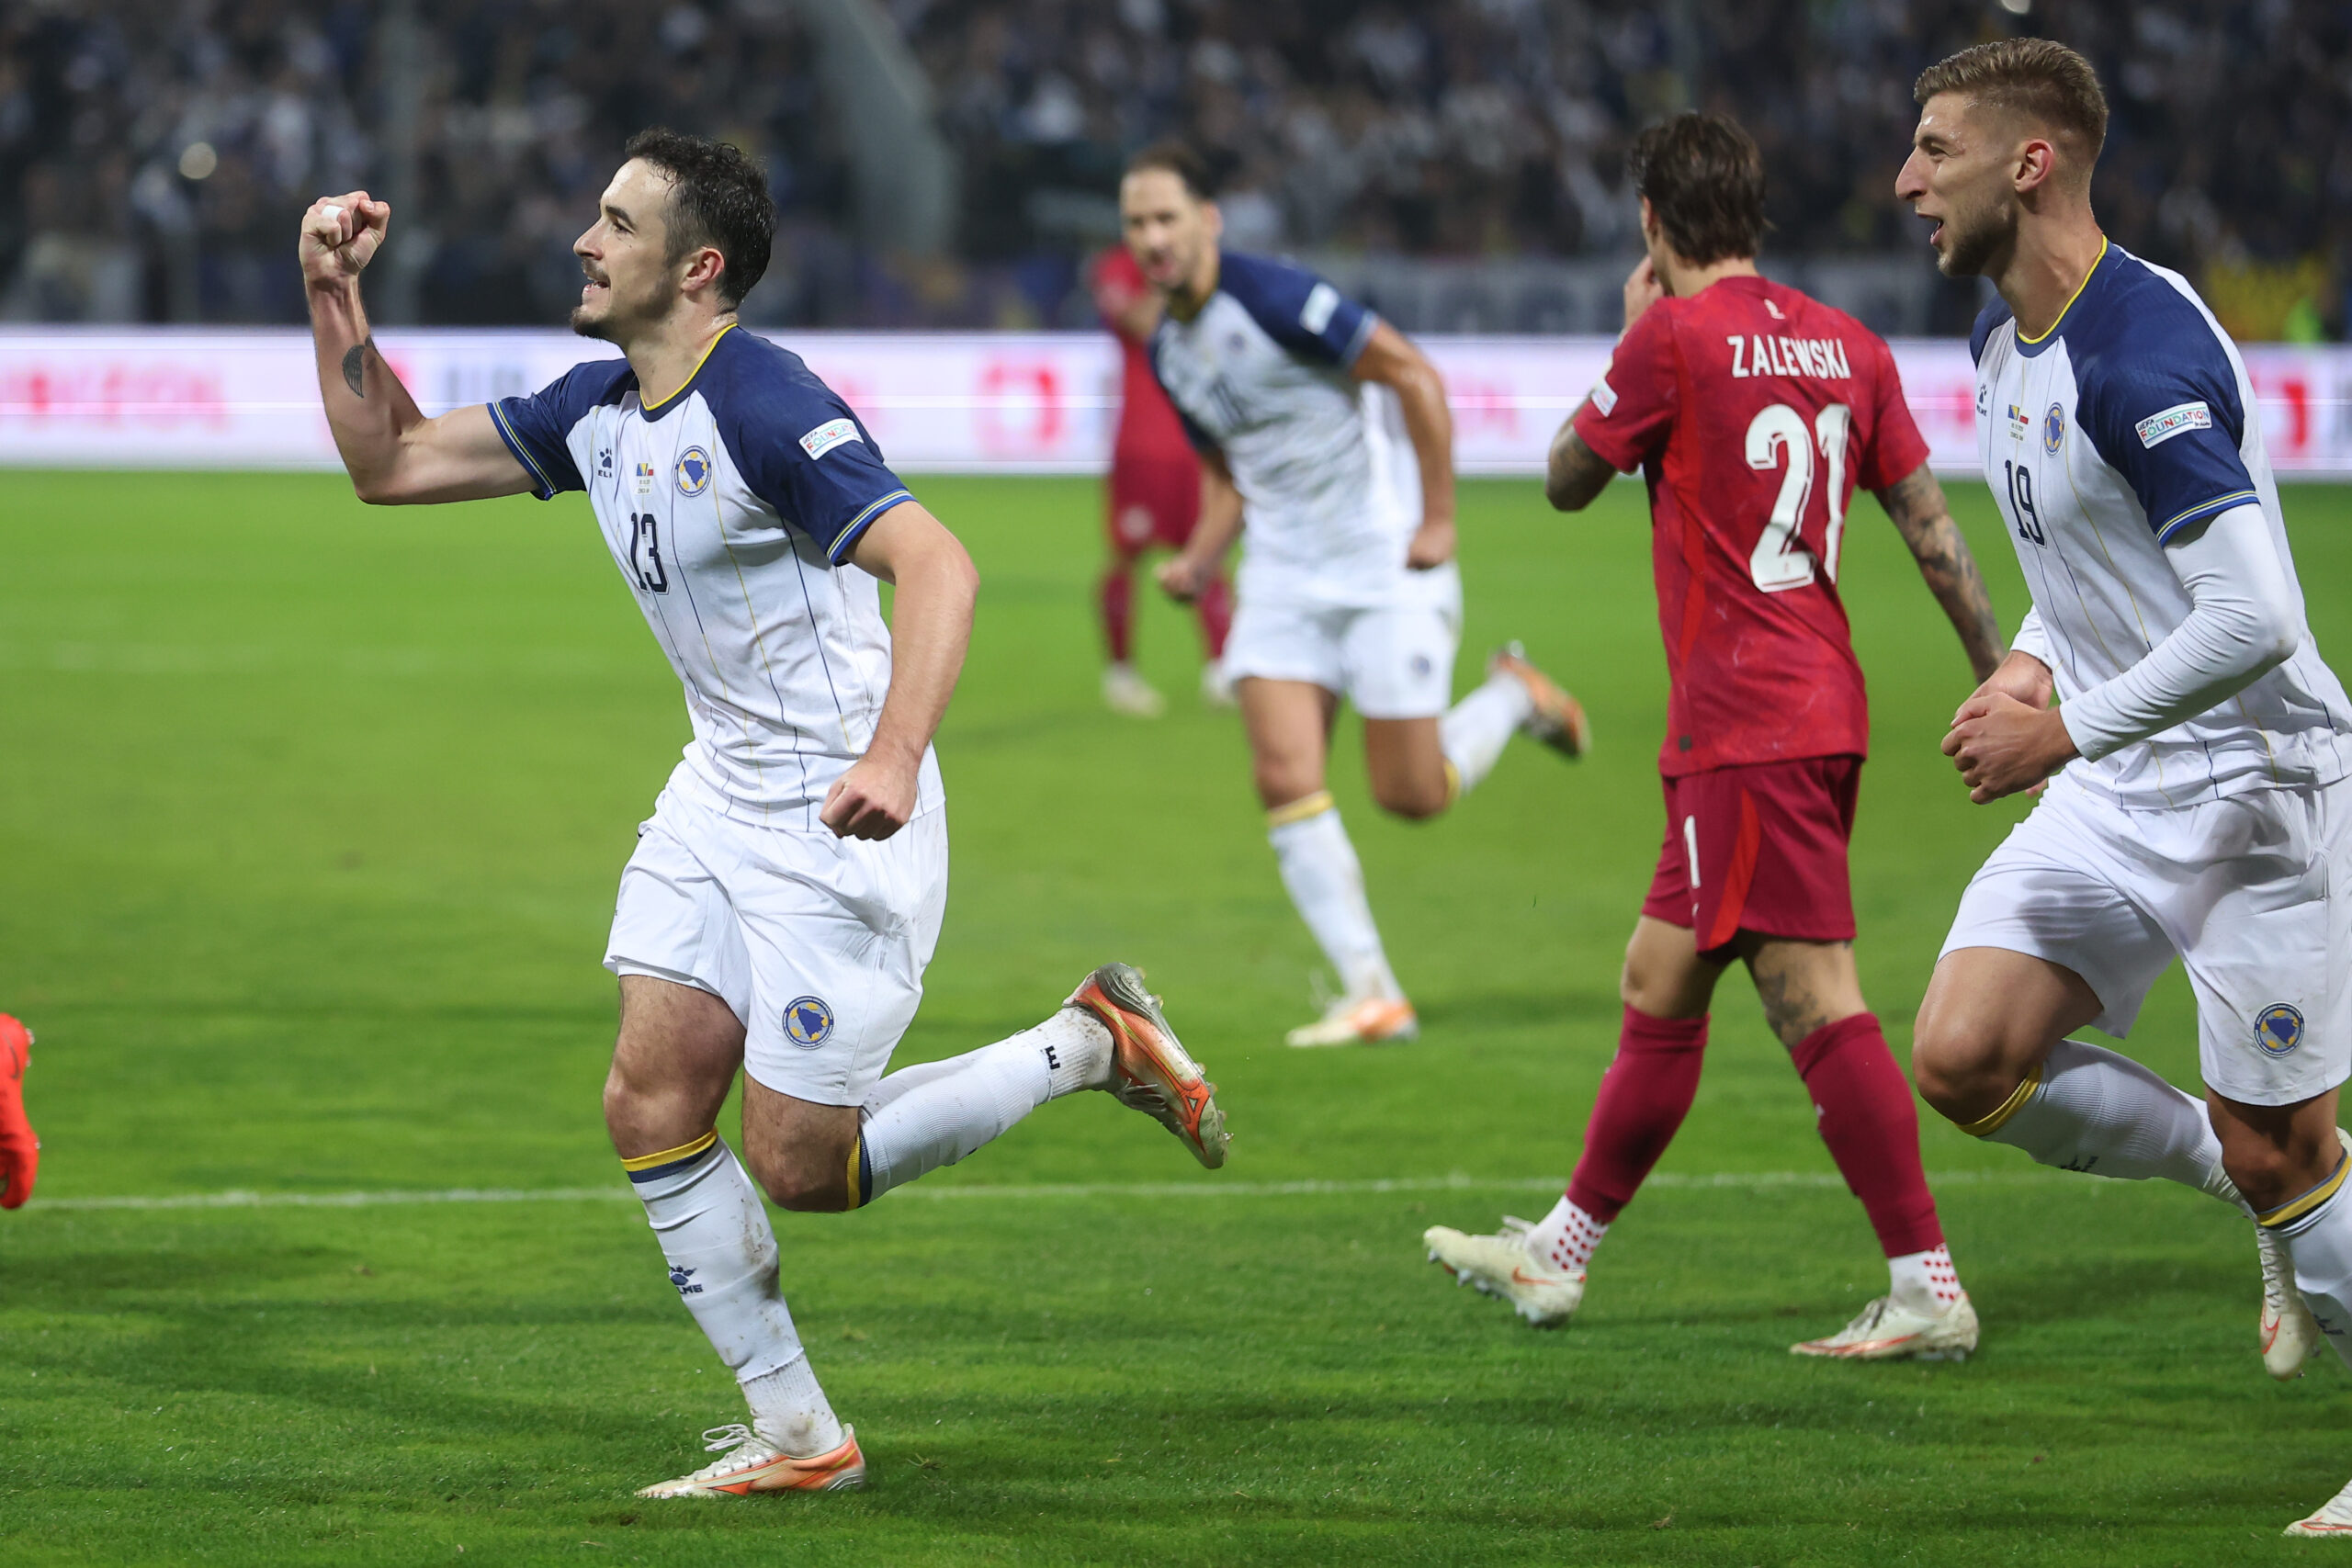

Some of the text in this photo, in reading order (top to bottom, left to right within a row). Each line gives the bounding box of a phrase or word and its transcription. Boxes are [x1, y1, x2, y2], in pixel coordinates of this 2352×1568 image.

[1726, 334, 1851, 379] ZALEWSKI
[2137, 418, 2155, 432] UEFA
[2140, 410, 2210, 441] FOUNDATION
[1746, 402, 1851, 593] 21
[2005, 459, 2048, 549] 19
[630, 512, 670, 595] 13
